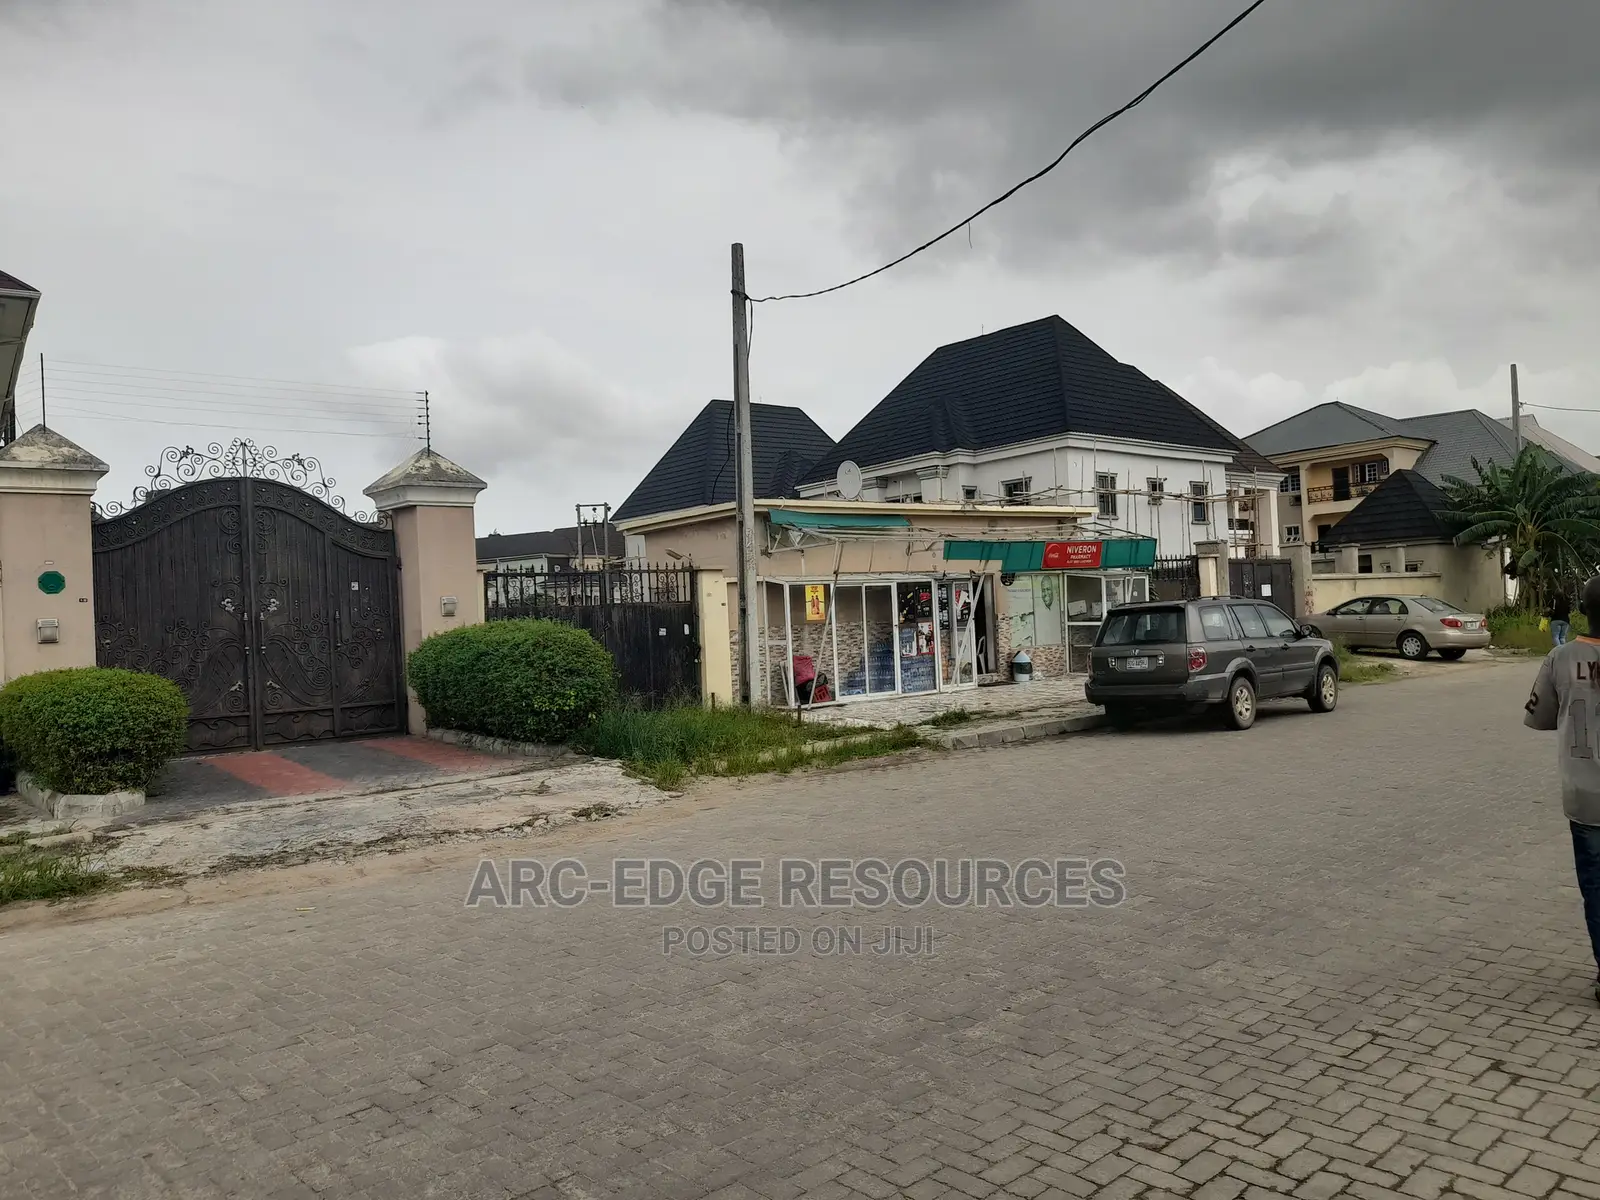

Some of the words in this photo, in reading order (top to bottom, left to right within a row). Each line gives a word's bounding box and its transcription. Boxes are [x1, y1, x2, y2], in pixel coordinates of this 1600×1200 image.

[1066, 545, 1097, 554] NIVERON
[1577, 661, 1600, 680] LY
[1569, 699, 1600, 760] 1
